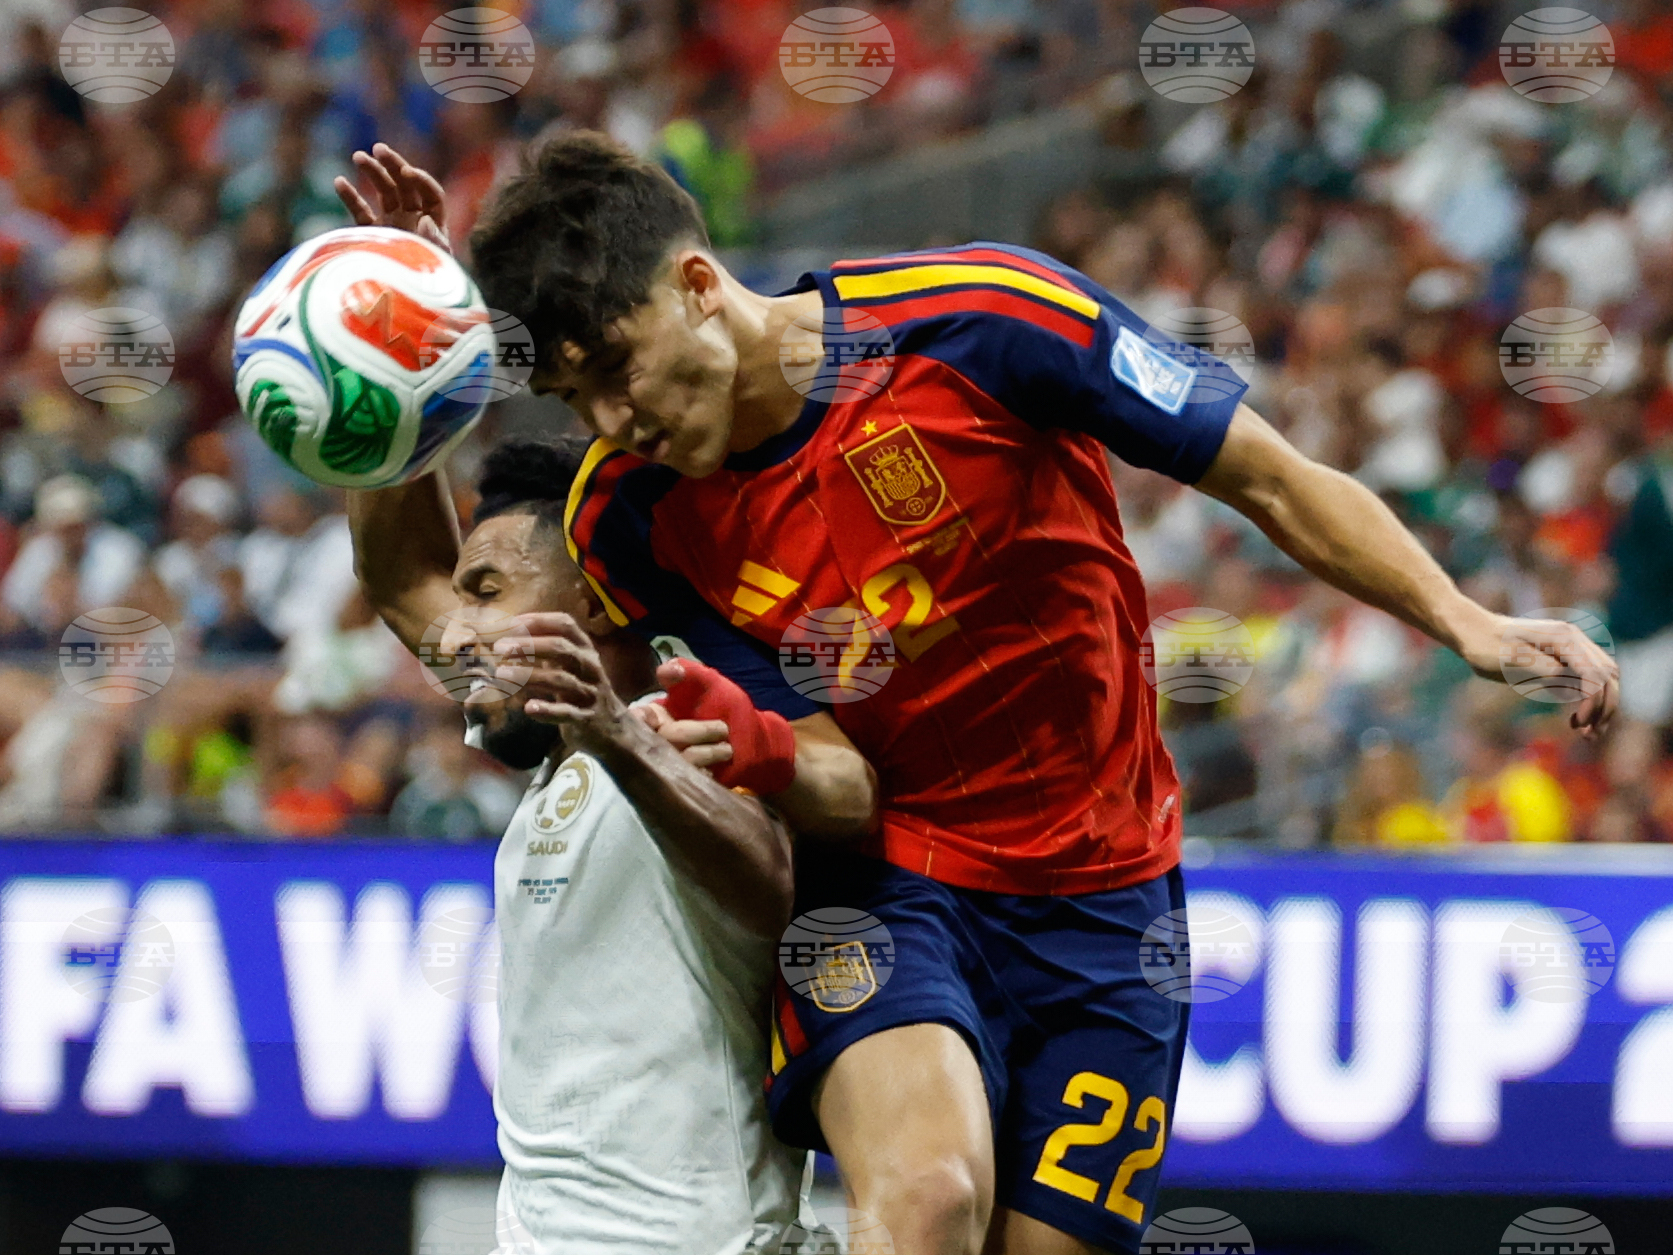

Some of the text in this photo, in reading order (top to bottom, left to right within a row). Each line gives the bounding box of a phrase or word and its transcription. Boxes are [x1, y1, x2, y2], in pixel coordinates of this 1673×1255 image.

[526, 840, 568, 856] SAUDI
[0, 875, 256, 1117] FA
[273, 878, 498, 1120] W
[1171, 892, 1589, 1146] CUP
[1031, 1070, 1166, 1225] 22
